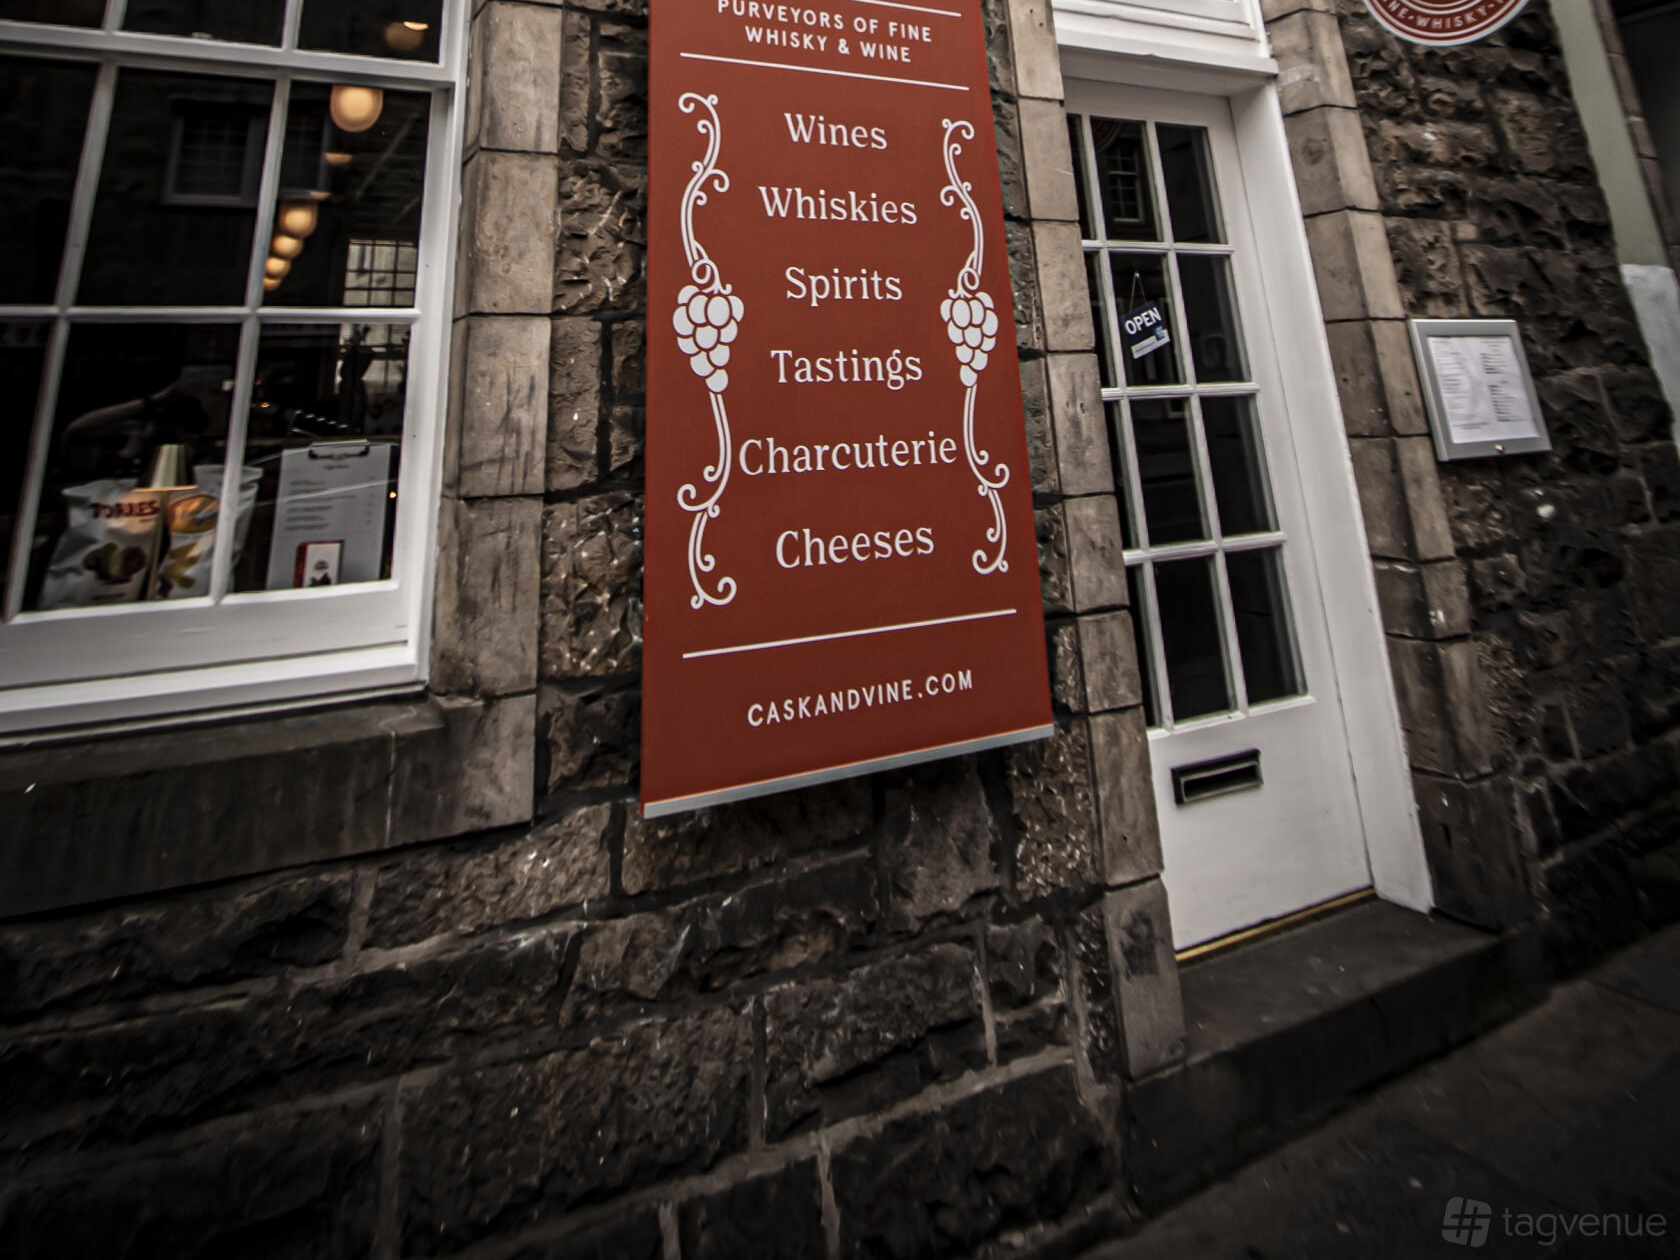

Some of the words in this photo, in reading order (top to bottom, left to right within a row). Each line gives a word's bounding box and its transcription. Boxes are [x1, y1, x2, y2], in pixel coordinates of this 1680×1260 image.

[745, 26, 828, 52] WHISKY
[838, 38, 850, 55] &
[860, 42, 912, 63] WINE
[853, 16, 879, 35] OF
[889, 21, 932, 43] FINE
[784, 113, 888, 150] Wines
[758, 186, 918, 225] Whiskies
[785, 266, 903, 307] Spirits
[1125, 307, 1162, 335] OPEN
[770, 349, 923, 390] Tastings
[738, 431, 957, 476] Charcuterie
[775, 526, 935, 569] Cheeses
[747, 669, 973, 727] CASKANDVINE.COM
